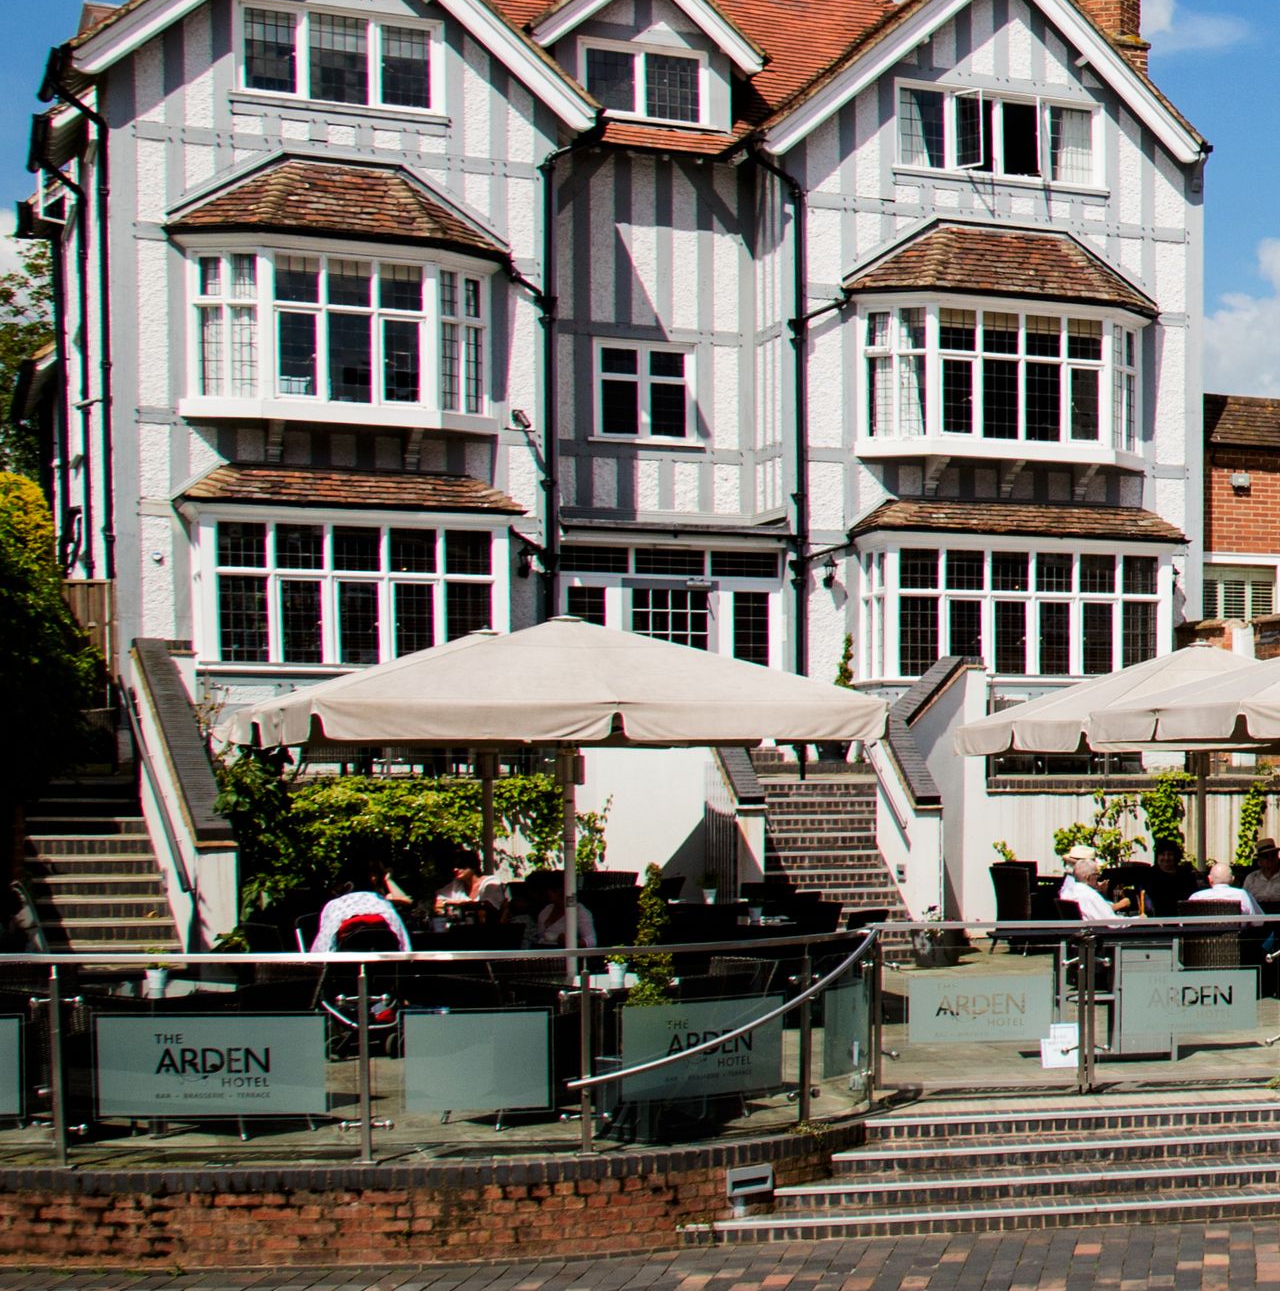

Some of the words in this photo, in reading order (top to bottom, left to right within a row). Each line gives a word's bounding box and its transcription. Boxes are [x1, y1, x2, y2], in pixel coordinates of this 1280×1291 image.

[1147, 985, 1233, 1008] ARDEN
[936, 992, 1025, 1016] ARDEN
[666, 1019, 689, 1029] THE
[987, 1018, 1025, 1027] HOTEL
[154, 1033, 183, 1044] THE
[666, 1029, 753, 1056] ARDEN
[155, 1047, 270, 1074] ARDEN
[718, 1055, 752, 1067] HOTEL
[221, 1077, 270, 1087] HOTEL
